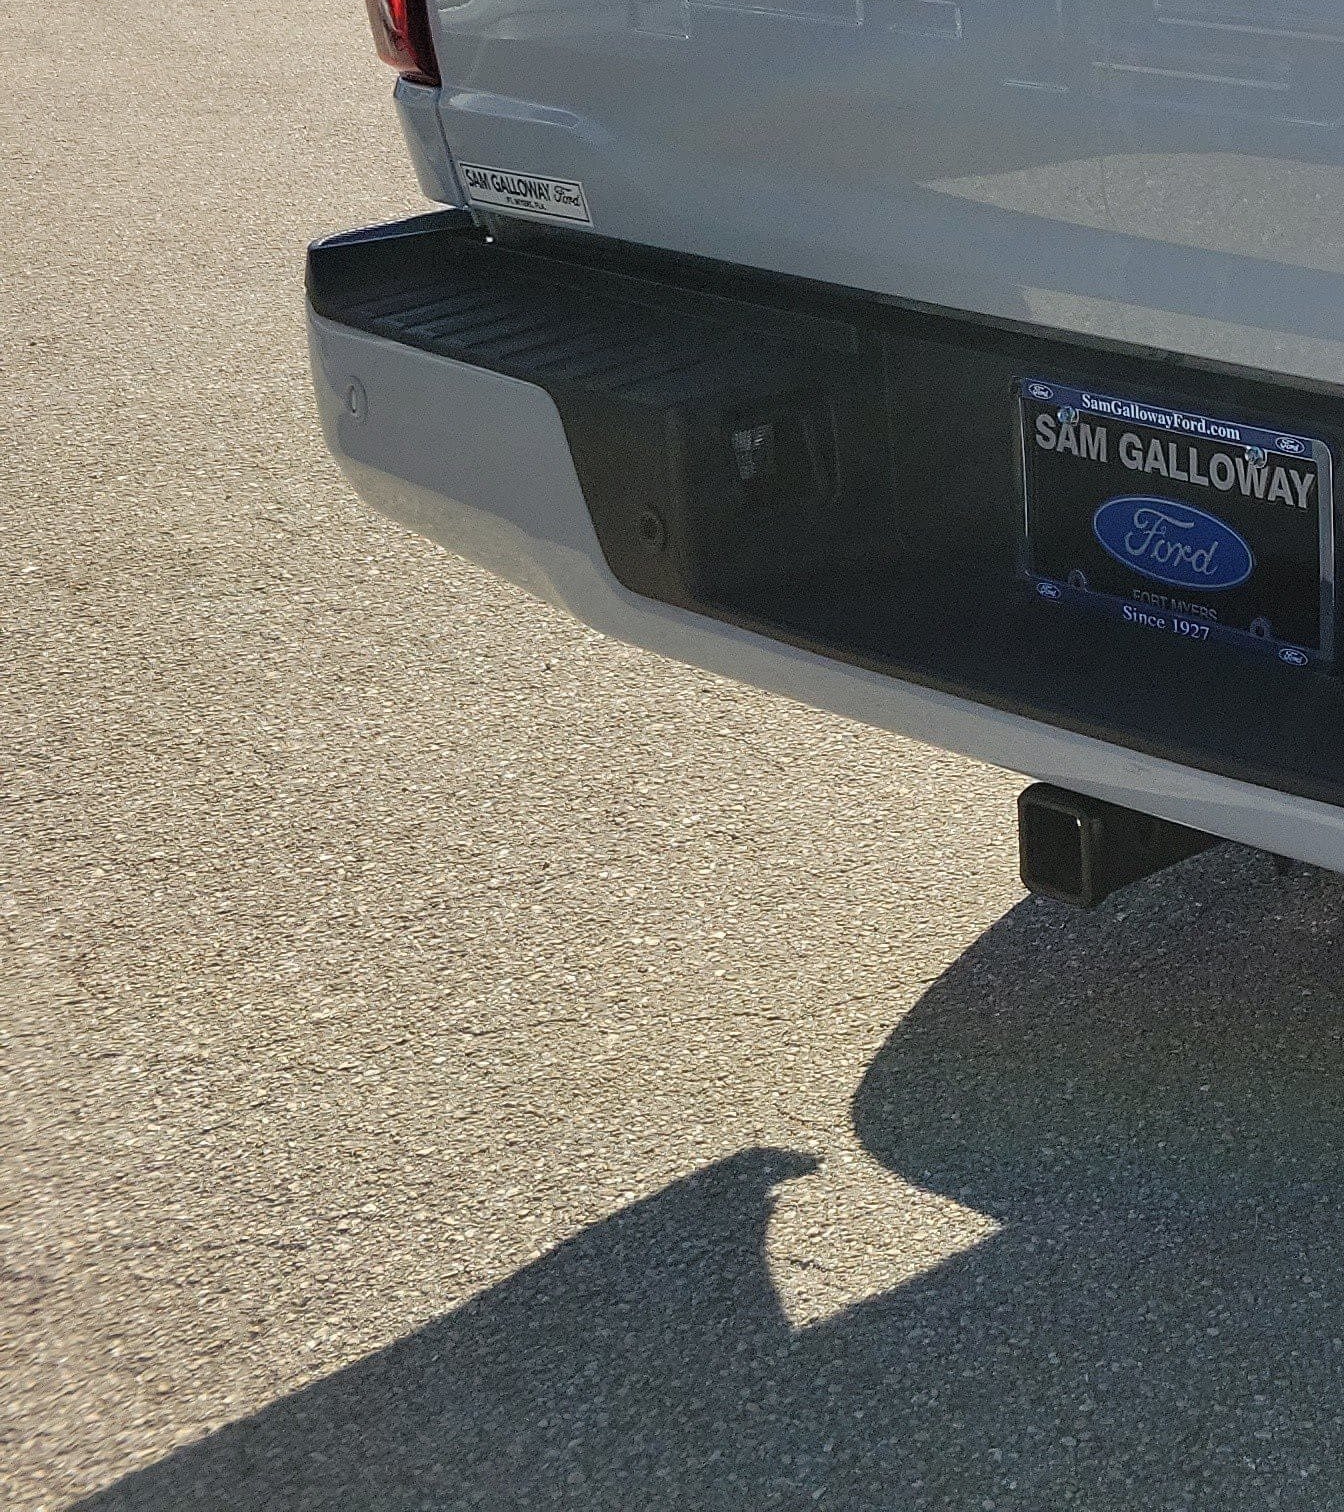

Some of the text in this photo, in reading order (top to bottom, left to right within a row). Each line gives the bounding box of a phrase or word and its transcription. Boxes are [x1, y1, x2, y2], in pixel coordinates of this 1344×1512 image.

[465, 169, 581, 207] SAM GALLOWAY Ford
[1081, 393, 1241, 441] SamGallowayFord.com
[1035, 413, 1316, 509] SAM GALLOWAY
[1124, 507, 1219, 576] Ford
[1121, 604, 1210, 641] Since 1927
[1170, 597, 1219, 621] MYERS
